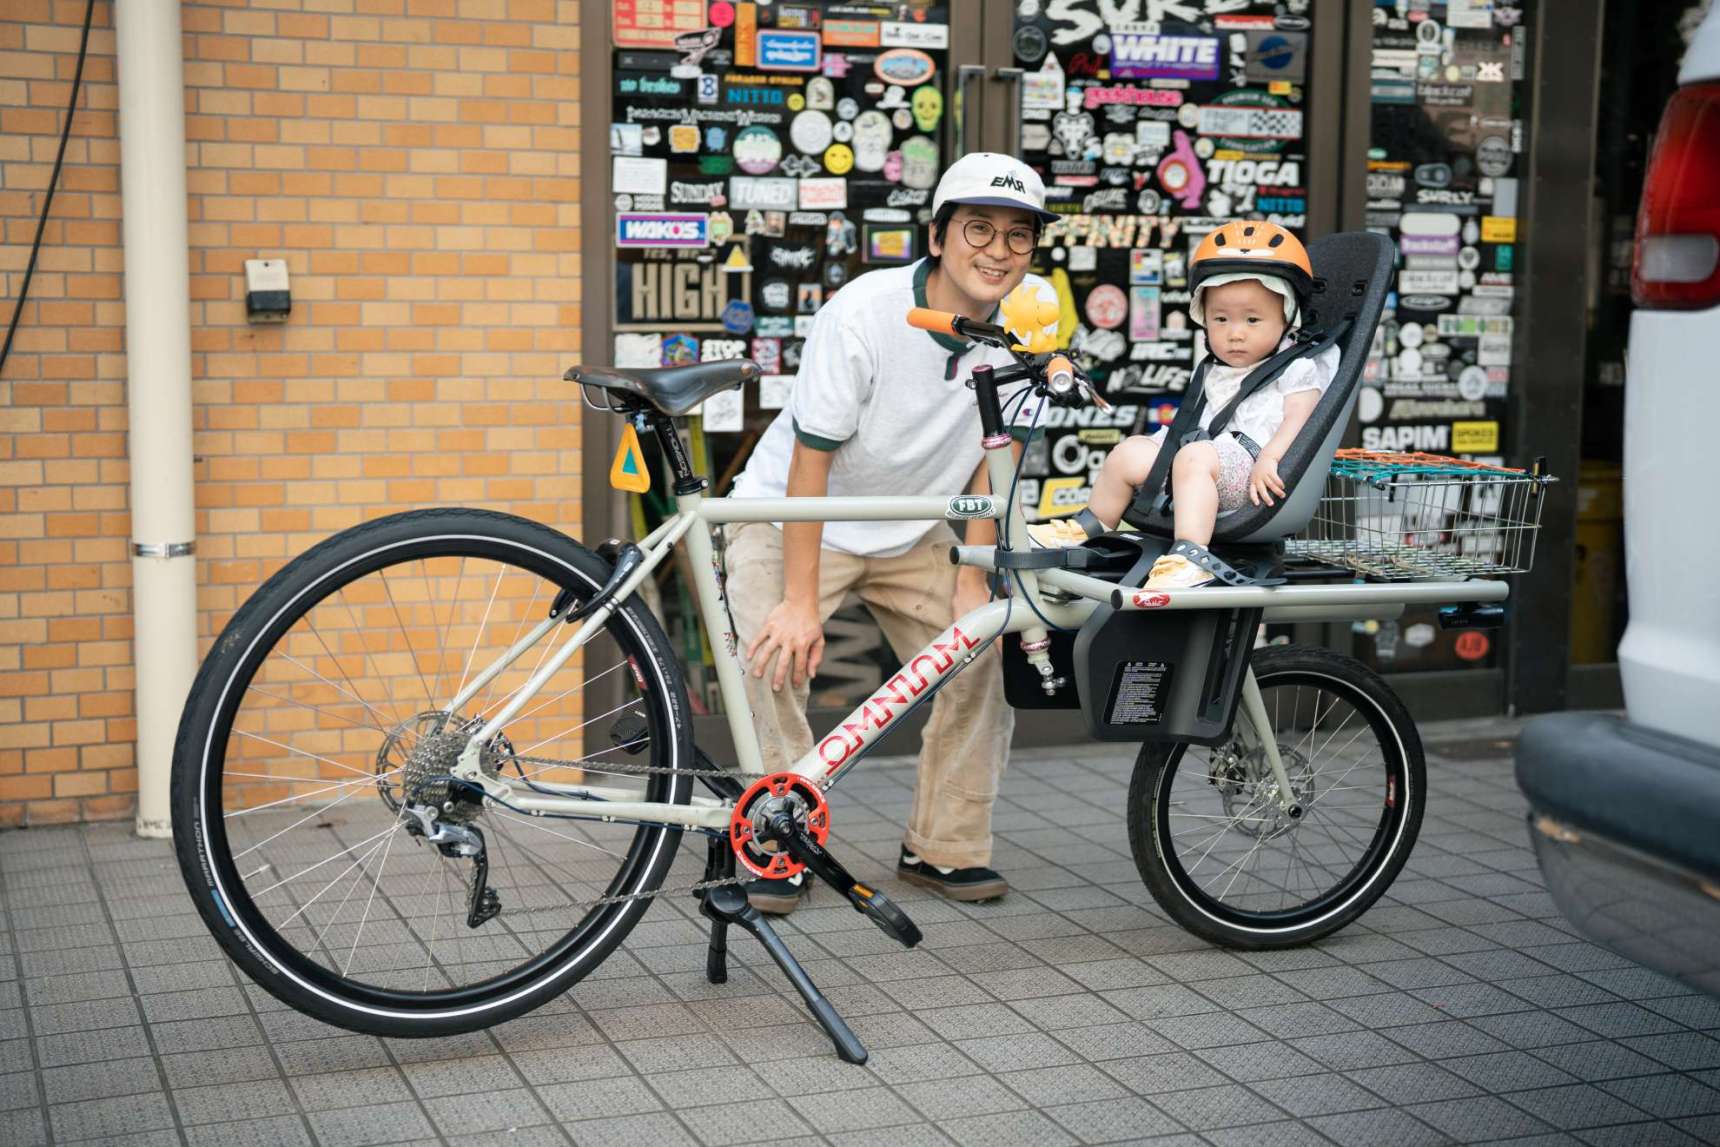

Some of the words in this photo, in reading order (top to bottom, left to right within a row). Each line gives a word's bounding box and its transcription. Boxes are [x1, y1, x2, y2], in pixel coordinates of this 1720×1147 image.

[1111, 36, 1218, 62] WHITE
[727, 88, 784, 104] NITTO
[1206, 160, 1300, 186] TIOGA
[1417, 189, 1474, 204] SURLY
[631, 263, 728, 320] HIGH
[1047, 405, 1138, 428] ONES
[1362, 425, 1447, 450] SAPIM
[958, 499, 983, 512] FBT
[818, 625, 982, 777] OMNIUM
